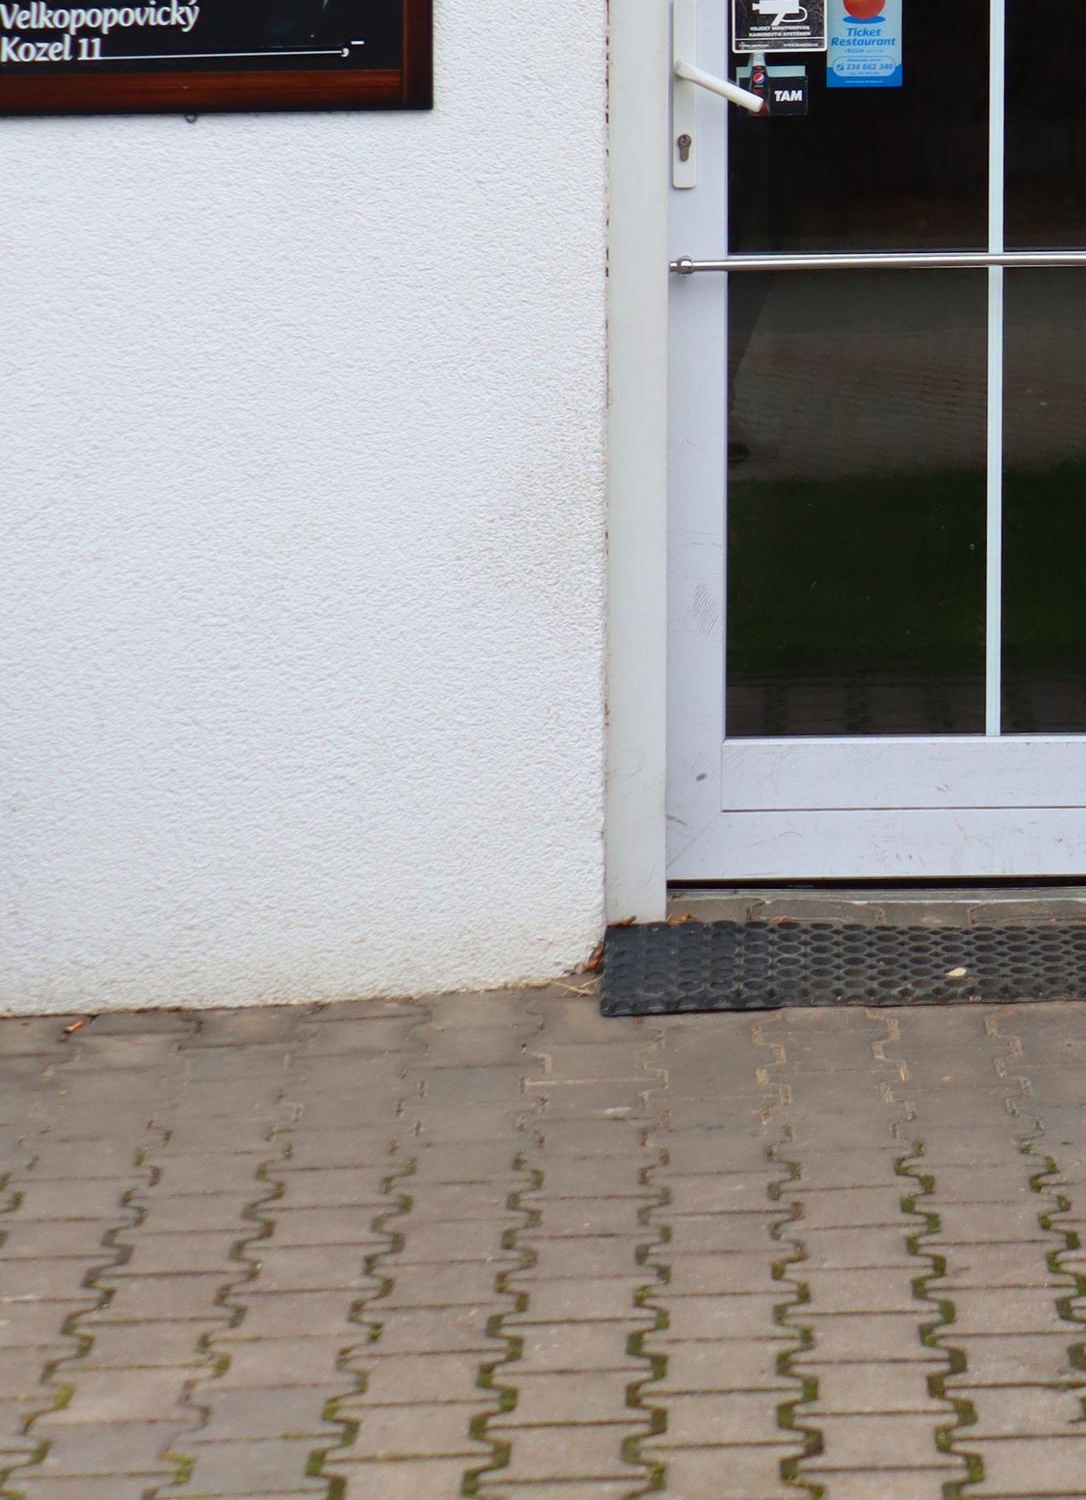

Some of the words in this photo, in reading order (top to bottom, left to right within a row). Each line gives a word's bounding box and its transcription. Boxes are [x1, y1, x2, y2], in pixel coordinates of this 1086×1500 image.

[847, 28, 881, 36] Ticket
[831, 37, 896, 46] Restaurant
[0, 34, 73, 62] Kozel
[77, 37, 102, 61] 11
[774, 90, 803, 102] TAM
